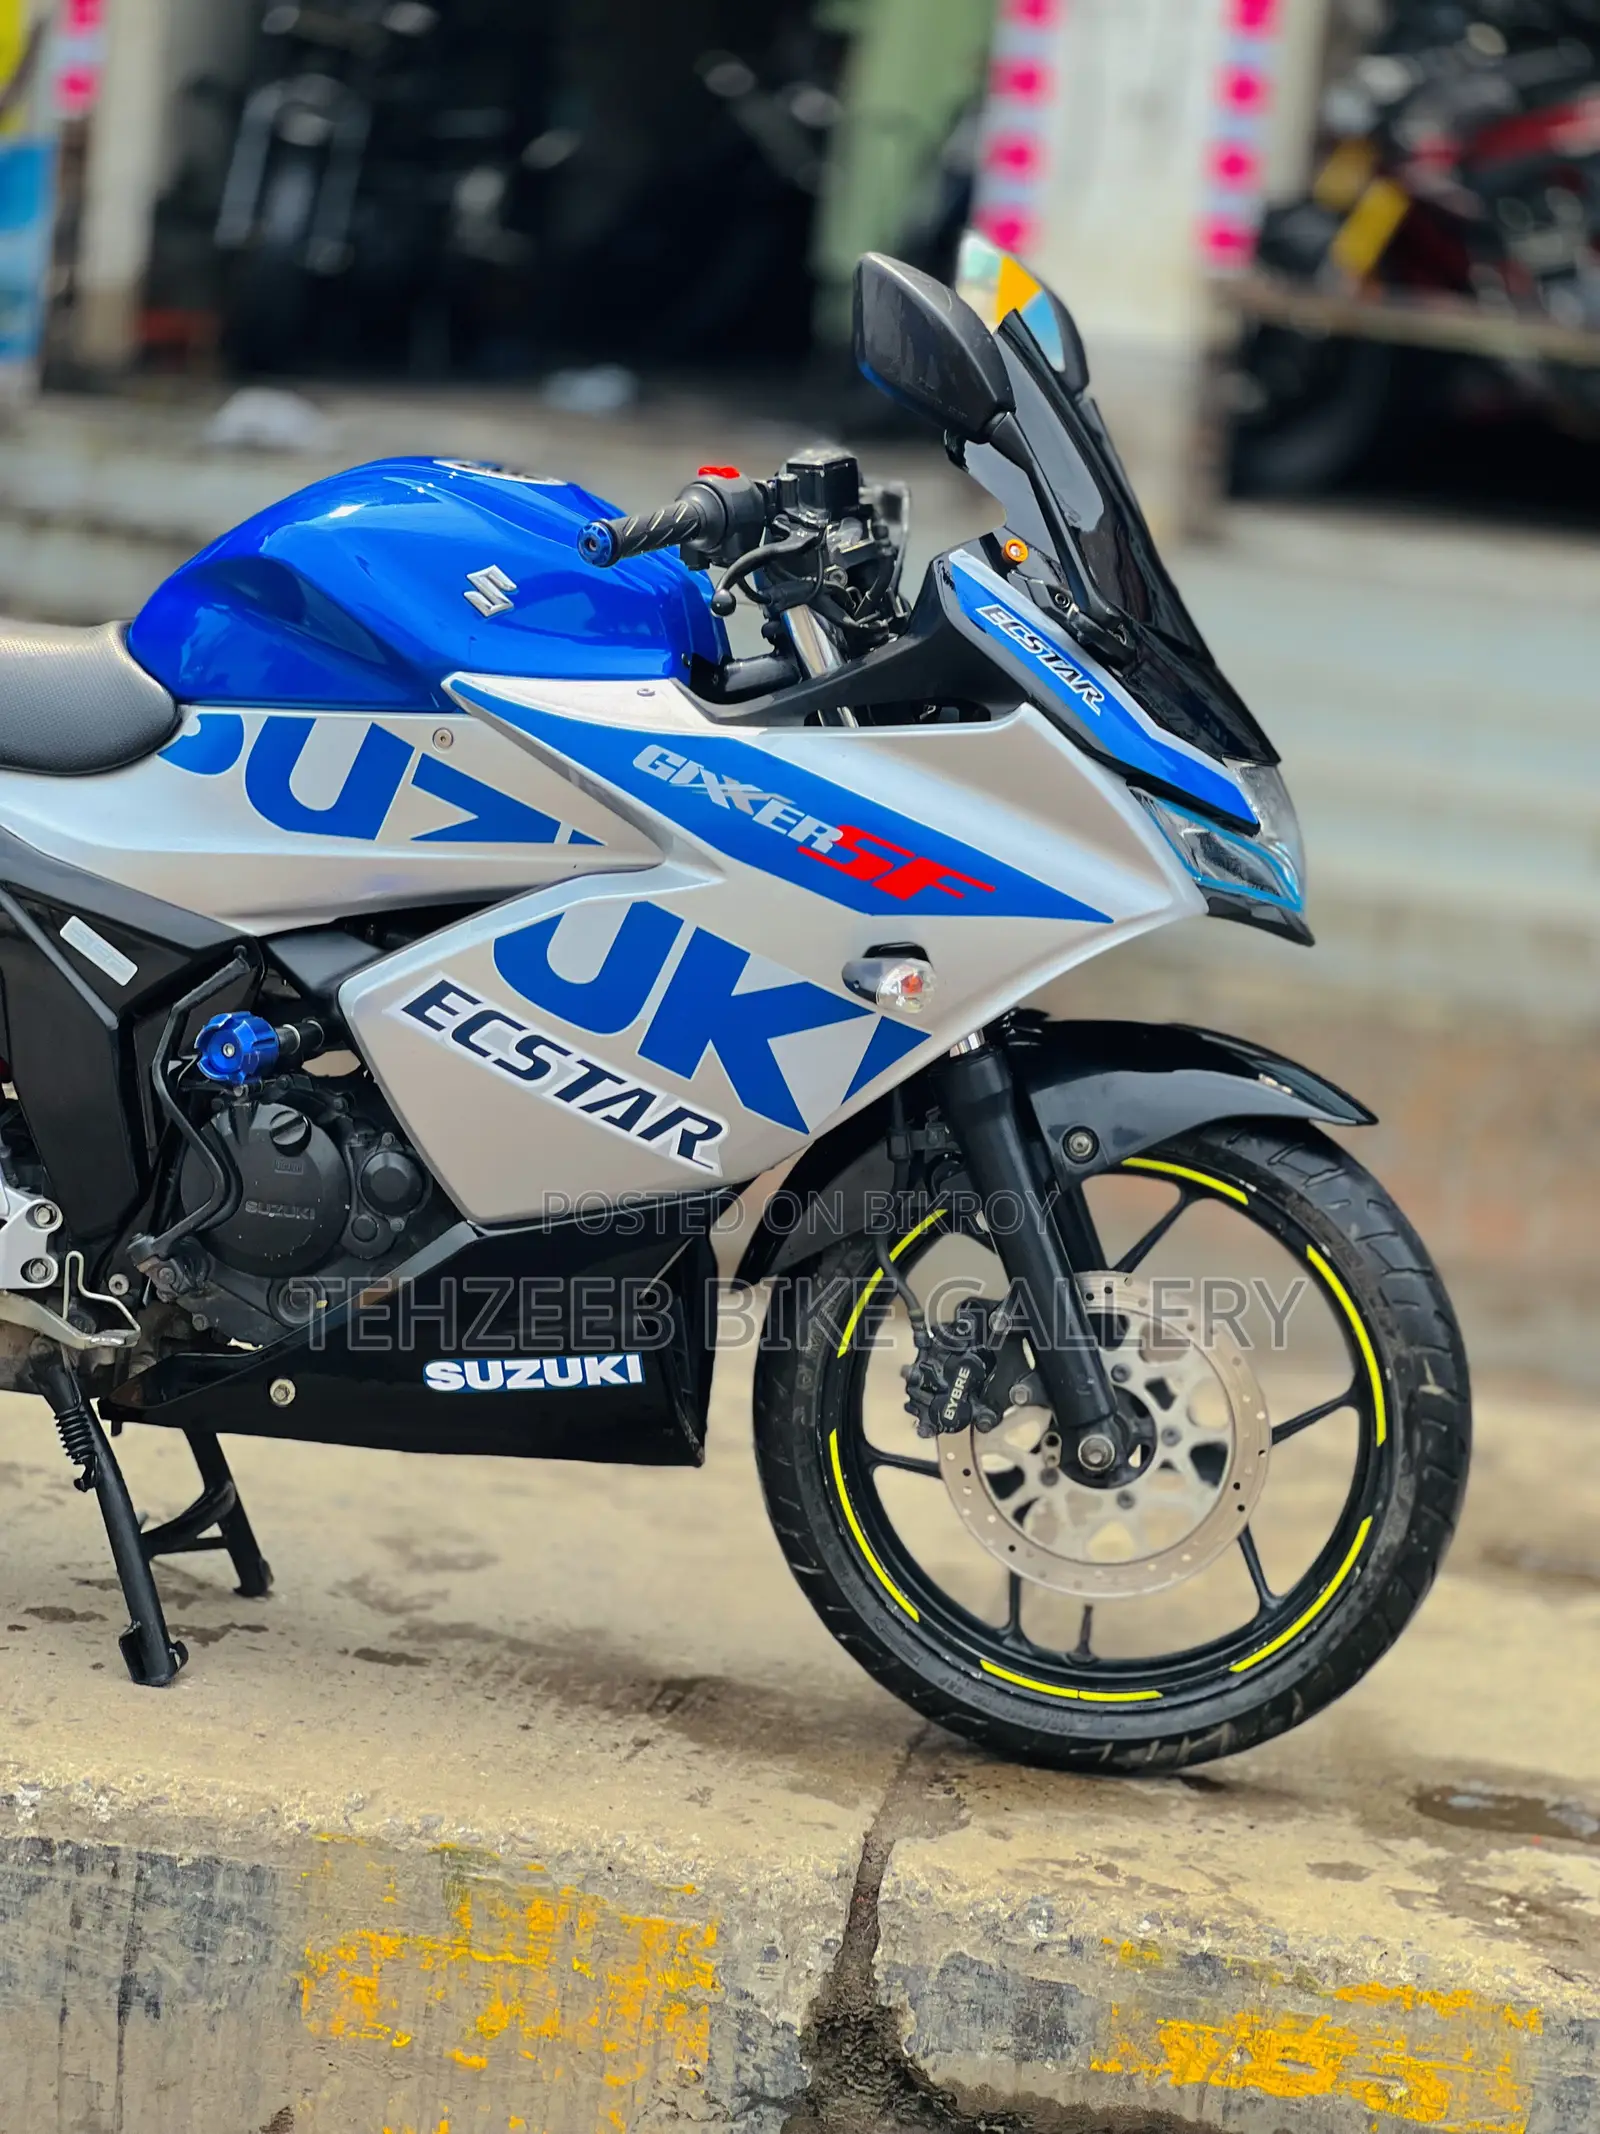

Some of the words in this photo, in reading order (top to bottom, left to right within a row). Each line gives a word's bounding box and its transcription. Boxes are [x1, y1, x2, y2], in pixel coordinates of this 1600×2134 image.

[975, 603, 1105, 716] ECSTAR
[632, 744, 844, 854] GIXXER
[797, 824, 996, 900] SF
[400, 978, 724, 1170] ECSTAR
[245, 1200, 316, 1220] SUZUKI
[425, 1354, 643, 1391] SUZUKI
[943, 1366, 971, 1421] BYBRE
